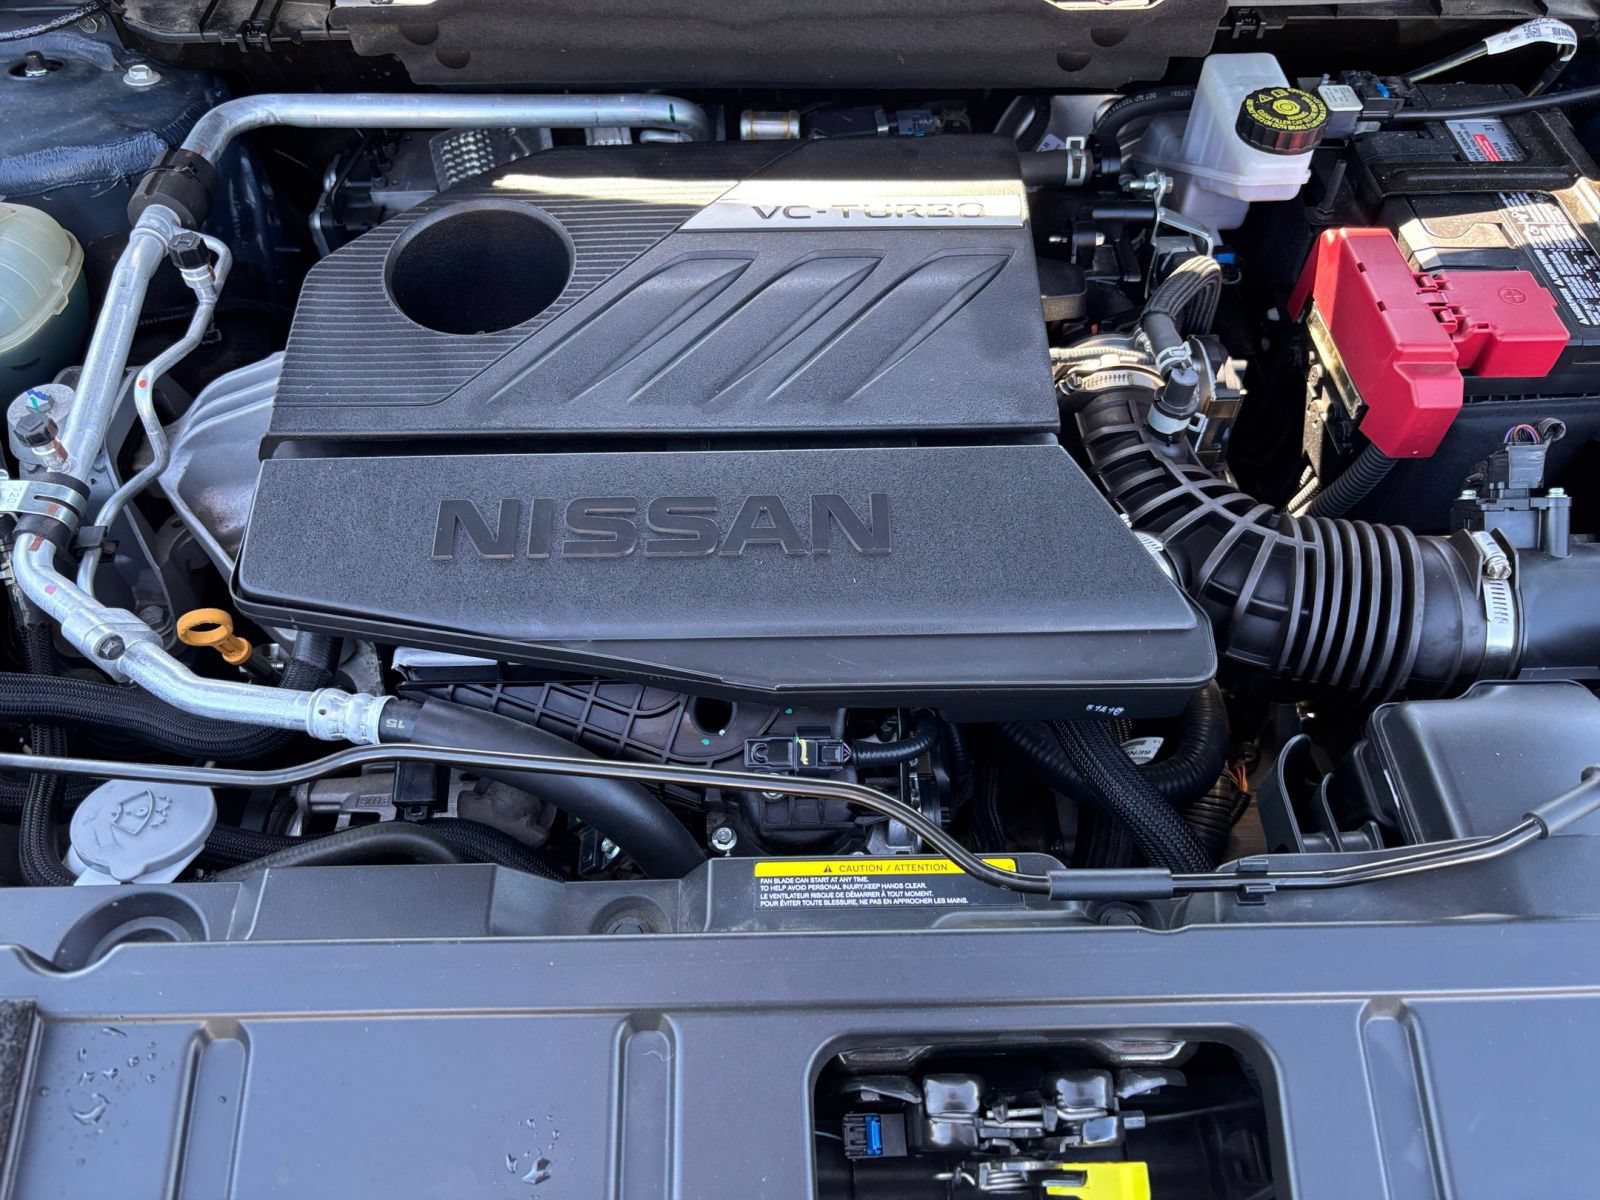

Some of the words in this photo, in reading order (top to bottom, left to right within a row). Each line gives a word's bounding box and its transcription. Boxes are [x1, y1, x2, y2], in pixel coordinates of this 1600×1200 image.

[752, 202, 985, 219] VC-TURBO
[431, 493, 893, 560] NISSAN
[839, 864, 883, 873] CAUTION
[894, 863, 948, 872] ATTENTION
[810, 891, 834, 899] RISQUE
[845, 890, 880, 898] DÉMARRER
[881, 889, 886, 897] À
[780, 898, 801, 906] ÉVITER
[893, 897, 933, 905] APPROCHER
